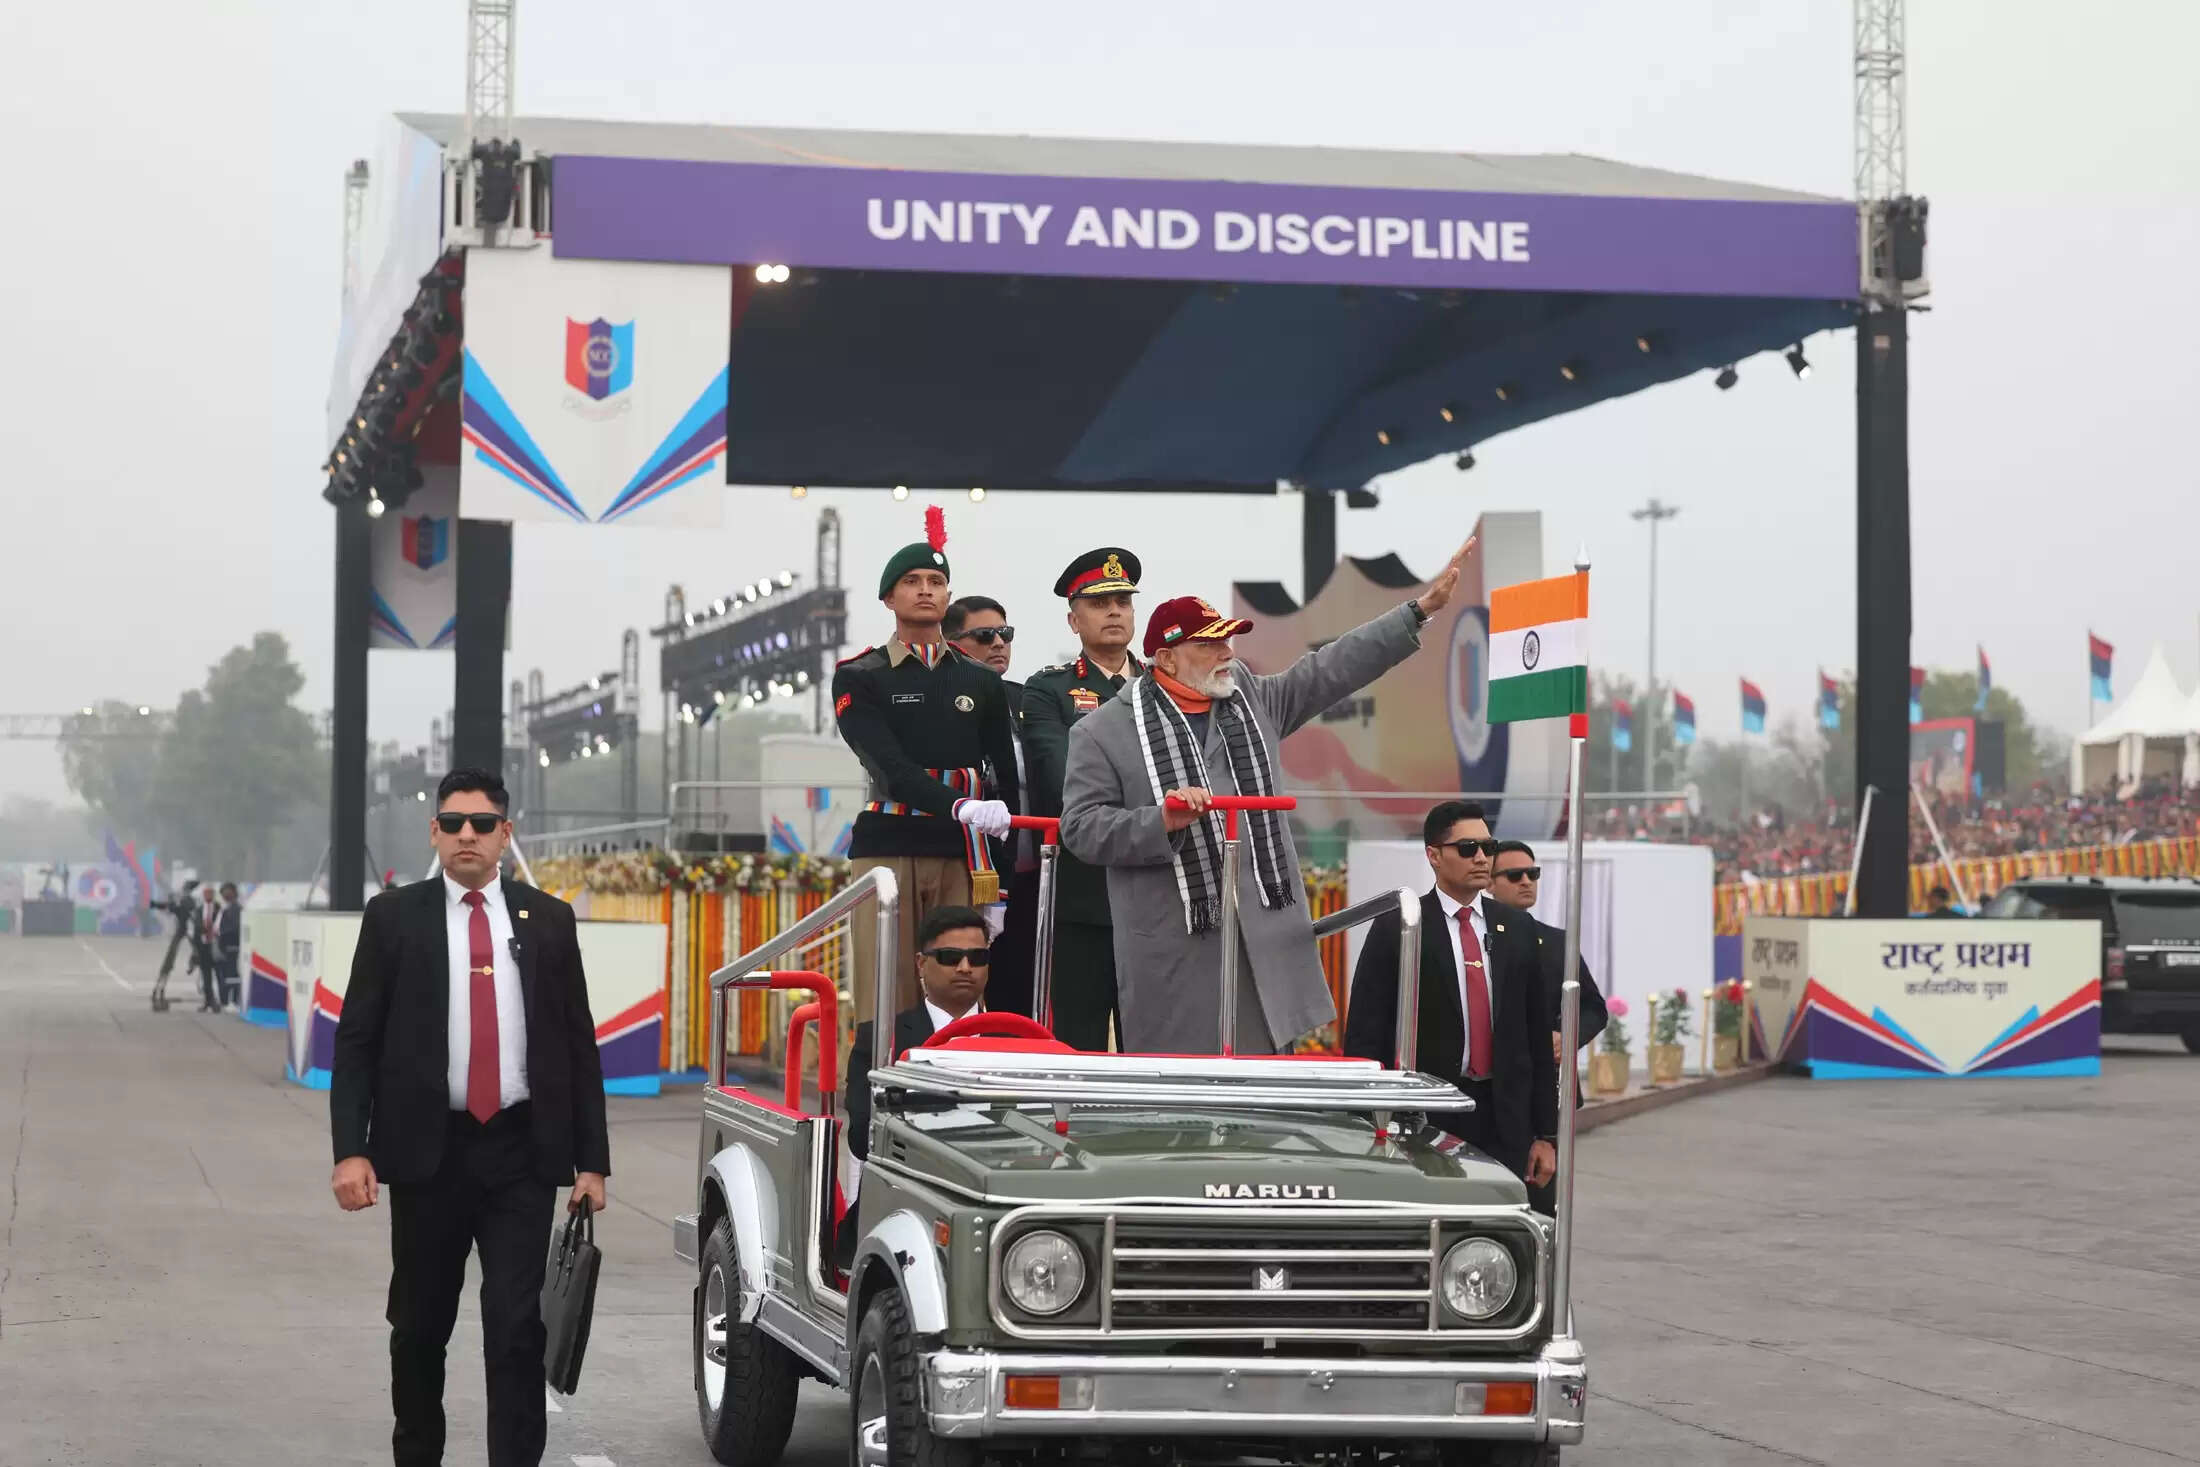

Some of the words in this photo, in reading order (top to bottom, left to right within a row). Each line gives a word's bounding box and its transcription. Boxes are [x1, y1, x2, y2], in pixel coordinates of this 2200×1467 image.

[867, 198, 1053, 245] UNITY
[1065, 206, 1200, 250] AND
[1214, 211, 1530, 262] DISCIPLINE
[1880, 942, 1944, 974] राष्ट्र
[1955, 942, 2032, 968] प्रथम
[1204, 1183, 1337, 1199] MARUTI
